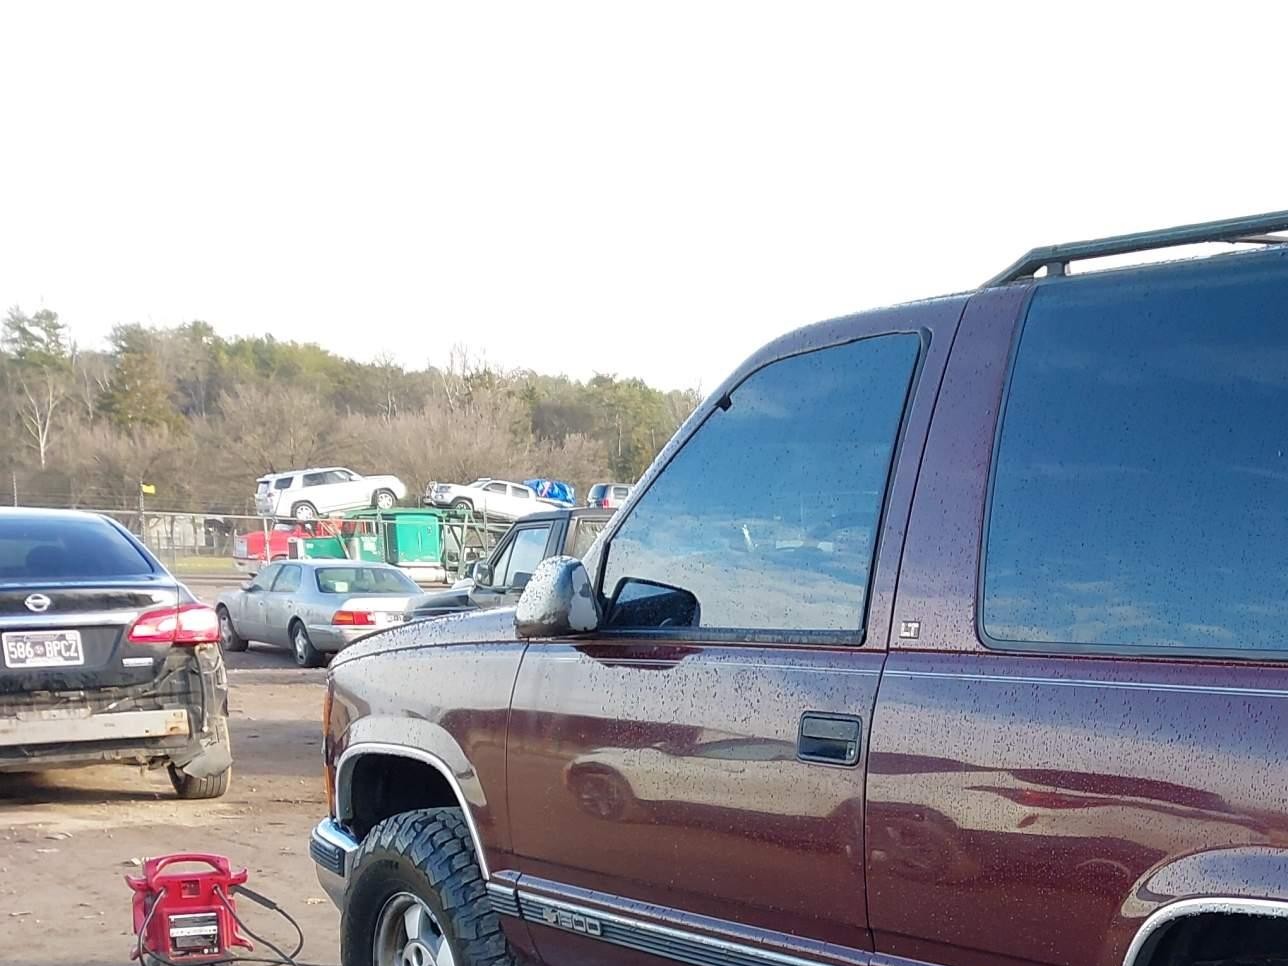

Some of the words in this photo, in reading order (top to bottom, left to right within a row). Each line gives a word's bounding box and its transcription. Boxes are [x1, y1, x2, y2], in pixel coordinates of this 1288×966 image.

[900, 621, 920, 638] LT
[7, 641, 34, 659] 586
[44, 640, 78, 657] BPCZ
